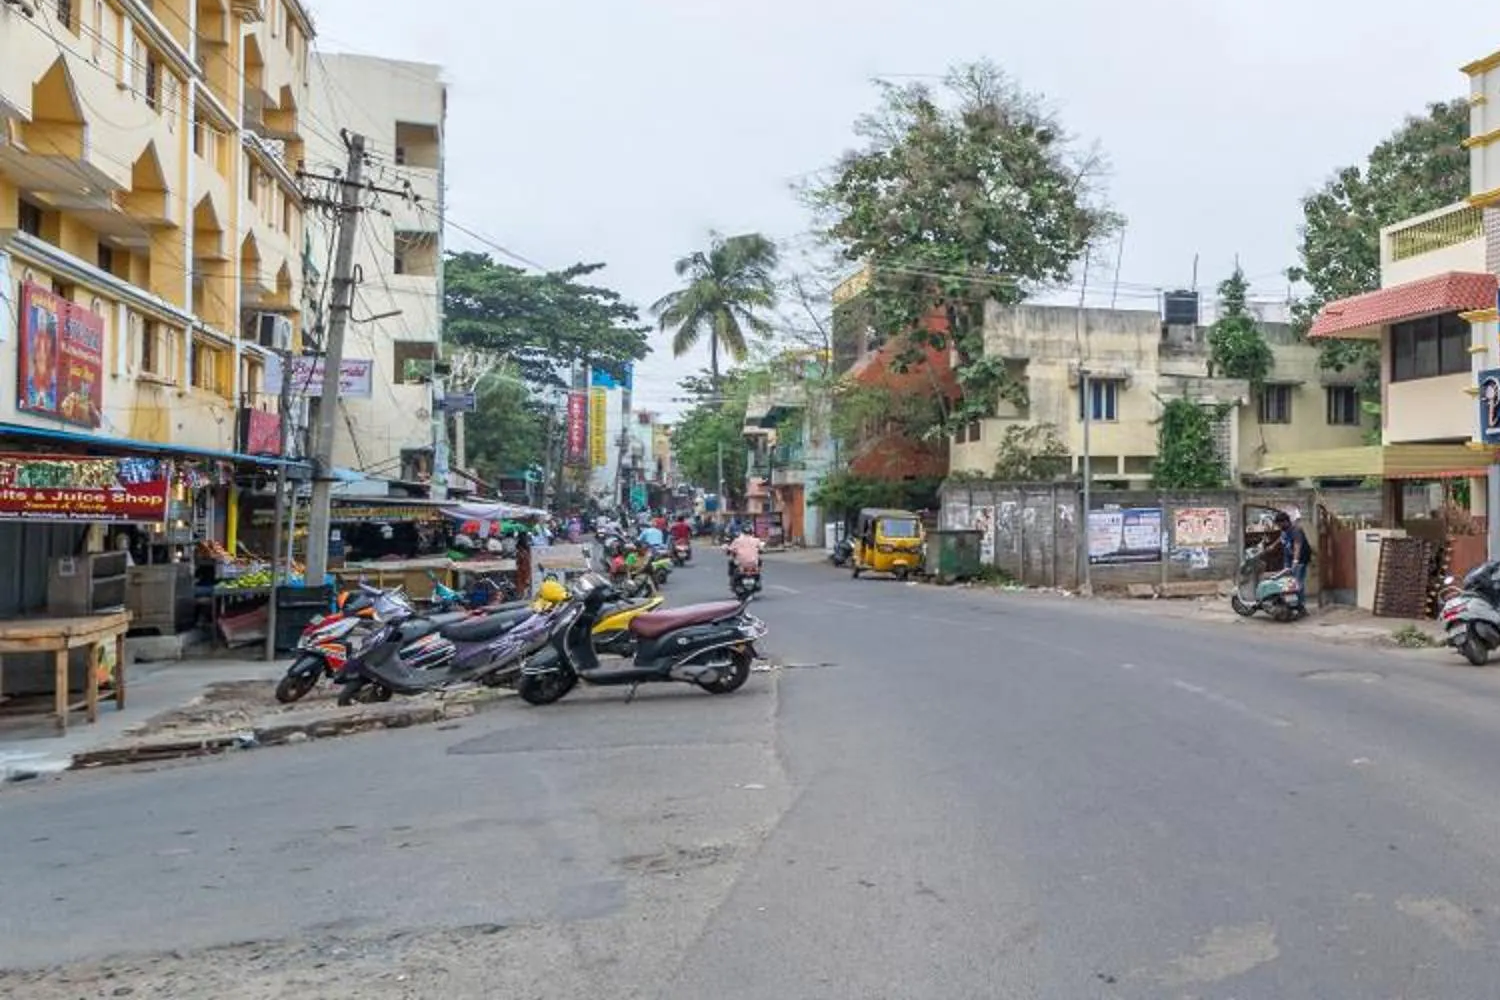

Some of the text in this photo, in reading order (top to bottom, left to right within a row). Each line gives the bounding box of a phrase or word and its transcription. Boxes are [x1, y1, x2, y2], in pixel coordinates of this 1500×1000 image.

[0, 489, 27, 500] its
[51, 491, 106, 503] Juice
[112, 493, 163, 506] Shop
